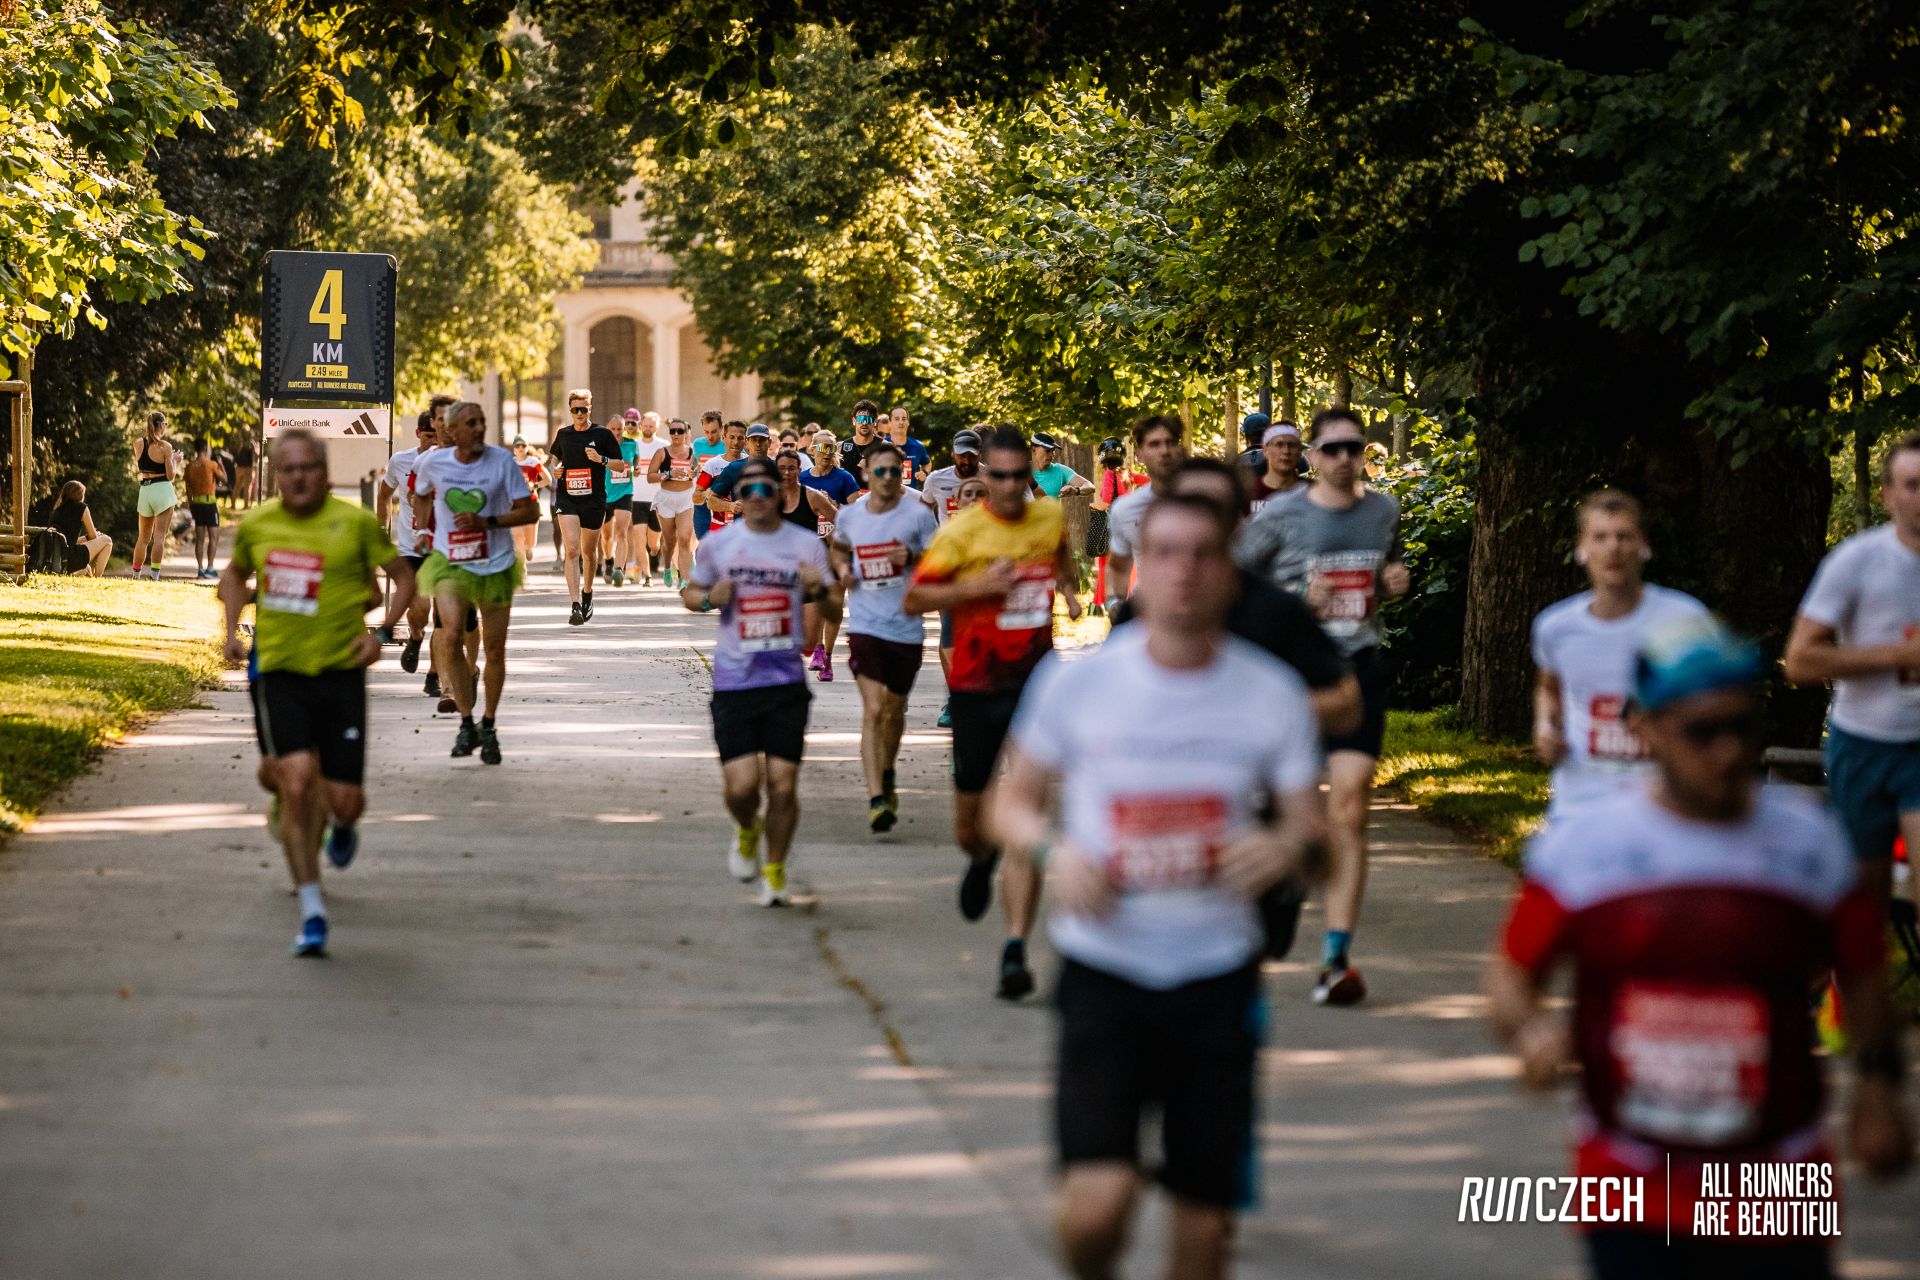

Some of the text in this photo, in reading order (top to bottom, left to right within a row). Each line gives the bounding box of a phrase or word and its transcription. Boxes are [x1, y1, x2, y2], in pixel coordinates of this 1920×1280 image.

[309, 269, 347, 340] 4
[313, 342, 343, 363] KM
[312, 366, 327, 376] 2.49
[278, 419, 330, 427] UniCredit Bank
[568, 480, 588, 489] 4032
